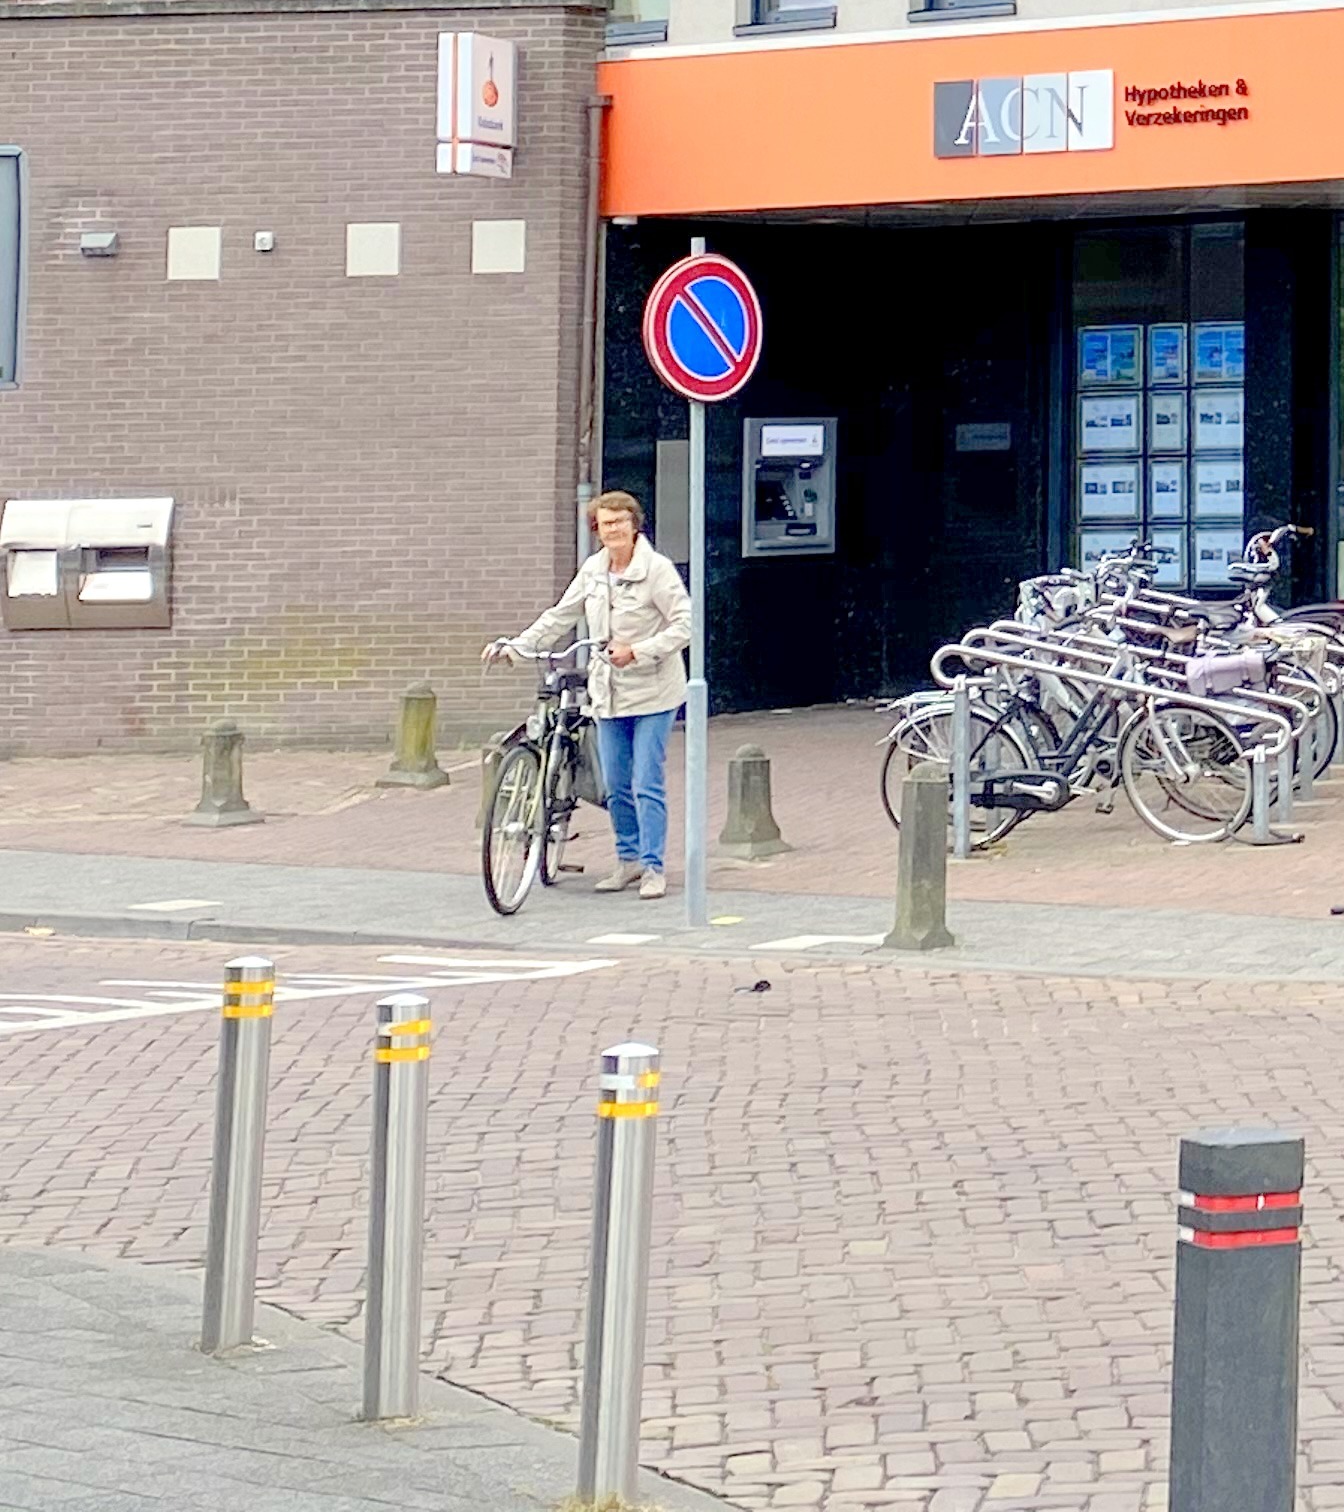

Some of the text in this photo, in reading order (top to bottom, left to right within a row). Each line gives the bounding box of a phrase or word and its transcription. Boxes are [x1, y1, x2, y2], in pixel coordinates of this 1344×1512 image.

[1124, 78, 1249, 107] Hypotheken &
[953, 84, 1090, 146] ACN
[1124, 105, 1249, 126] Verzekeringen
